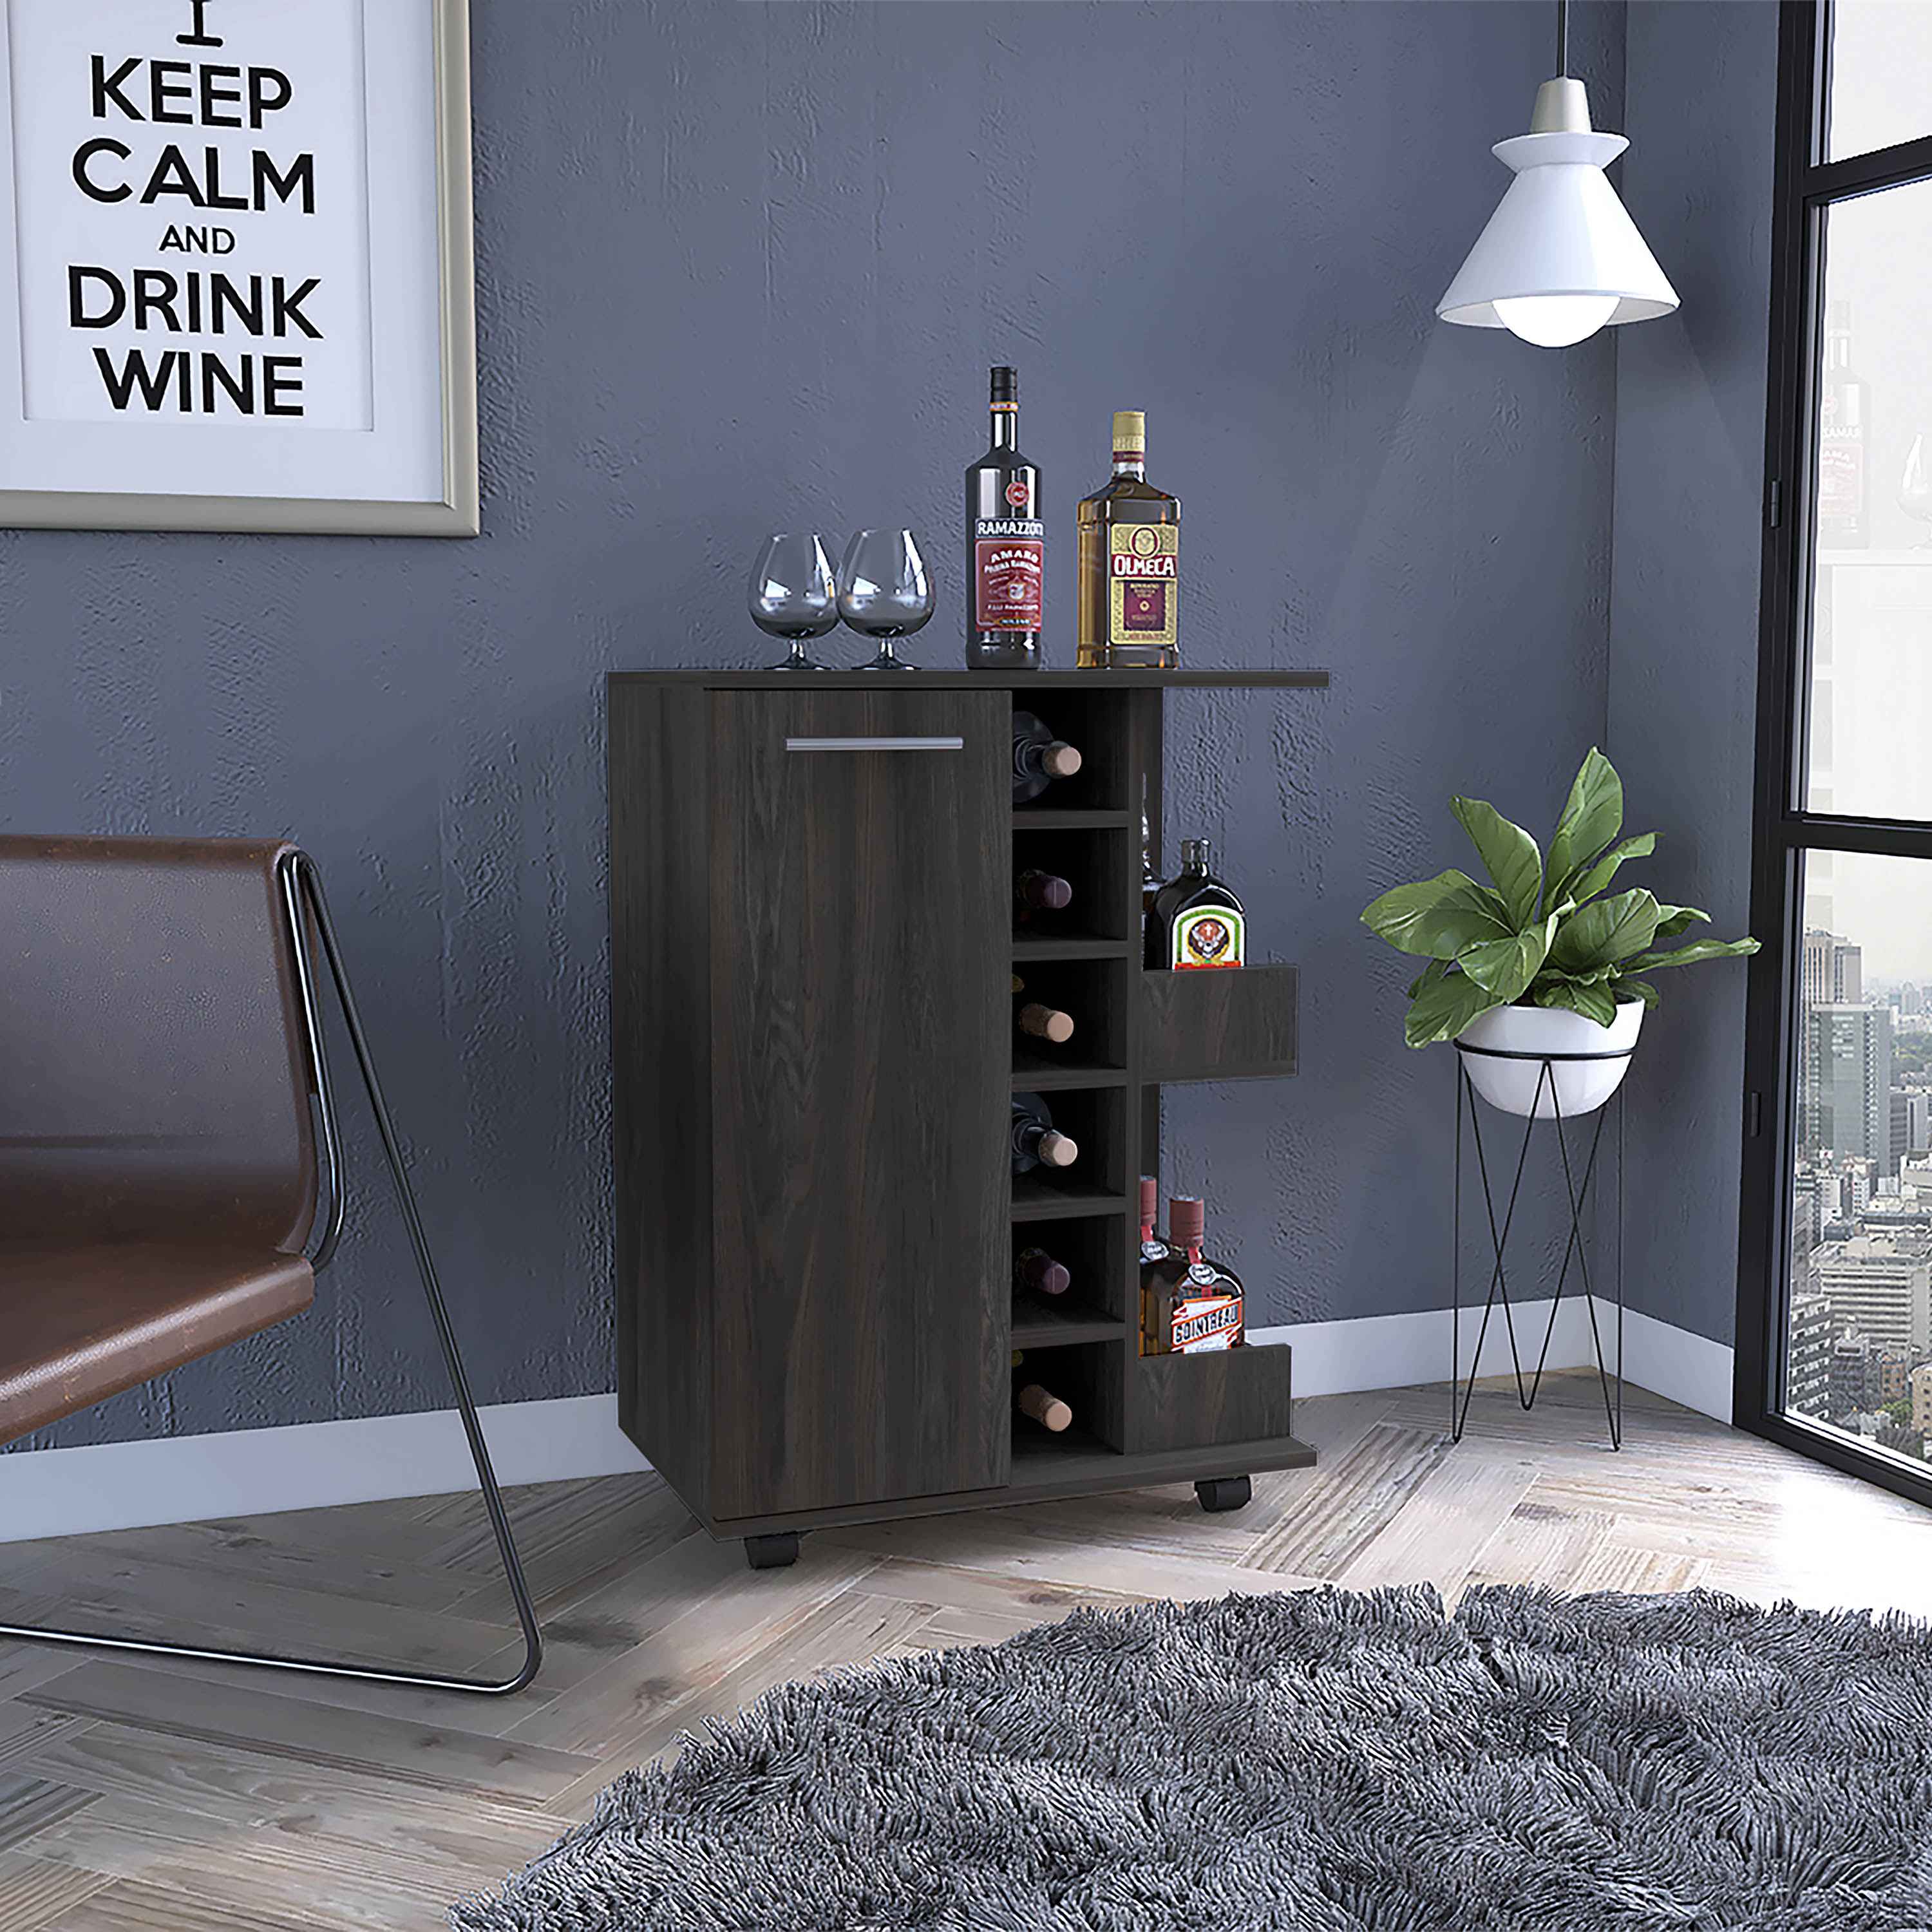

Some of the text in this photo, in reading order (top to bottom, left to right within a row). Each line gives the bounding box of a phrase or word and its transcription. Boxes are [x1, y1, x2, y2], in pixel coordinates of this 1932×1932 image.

[90, 55, 292, 129] KEEP
[72, 138, 315, 214] CALM
[158, 224, 235, 254] AND
[68, 265, 324, 339] DRINK
[92, 347, 304, 416] WINE
[1114, 554, 1175, 577] OLMECA
